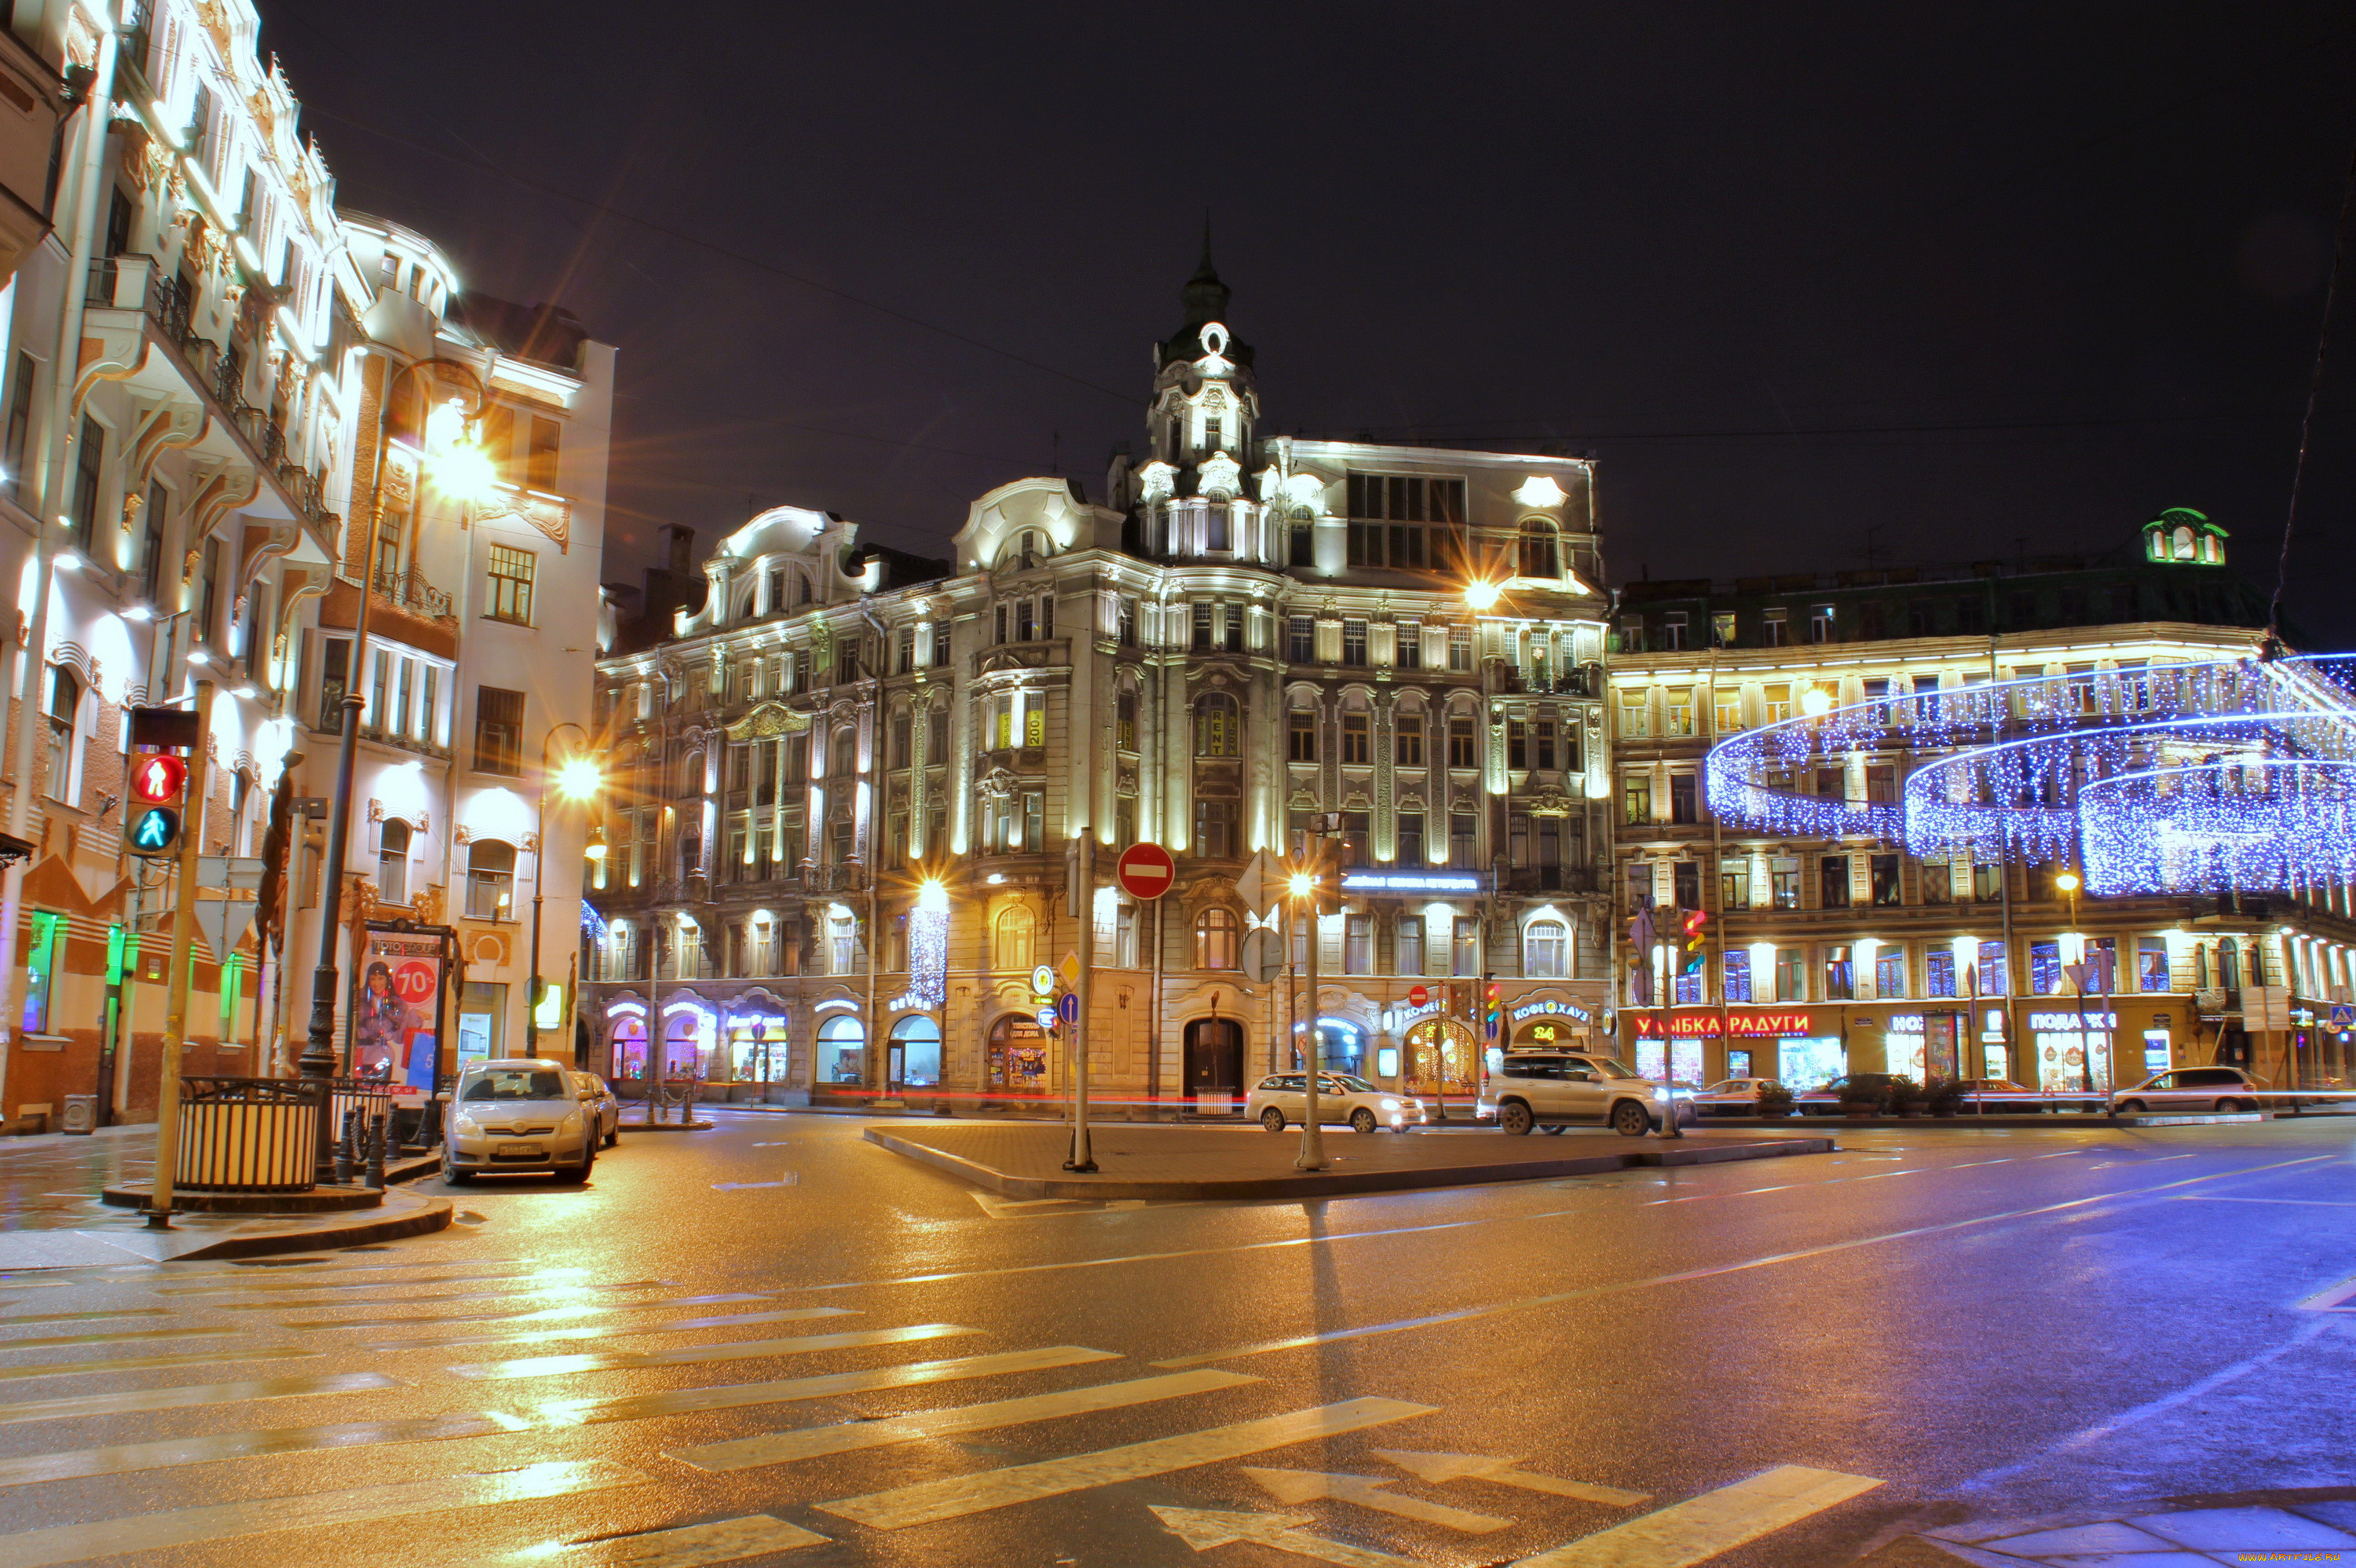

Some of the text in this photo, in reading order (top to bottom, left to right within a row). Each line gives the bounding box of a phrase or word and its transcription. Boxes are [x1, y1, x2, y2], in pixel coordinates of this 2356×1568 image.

[1030, 720, 1041, 745] 200
[1213, 711, 1222, 755] RENT
[889, 992, 932, 1012] SEVEN
[1513, 1003, 1589, 1022] КОФЕ ХАУЗ
[1534, 1026, 1554, 1040] 24
[1729, 1016, 1809, 1032] РАДУГИ
